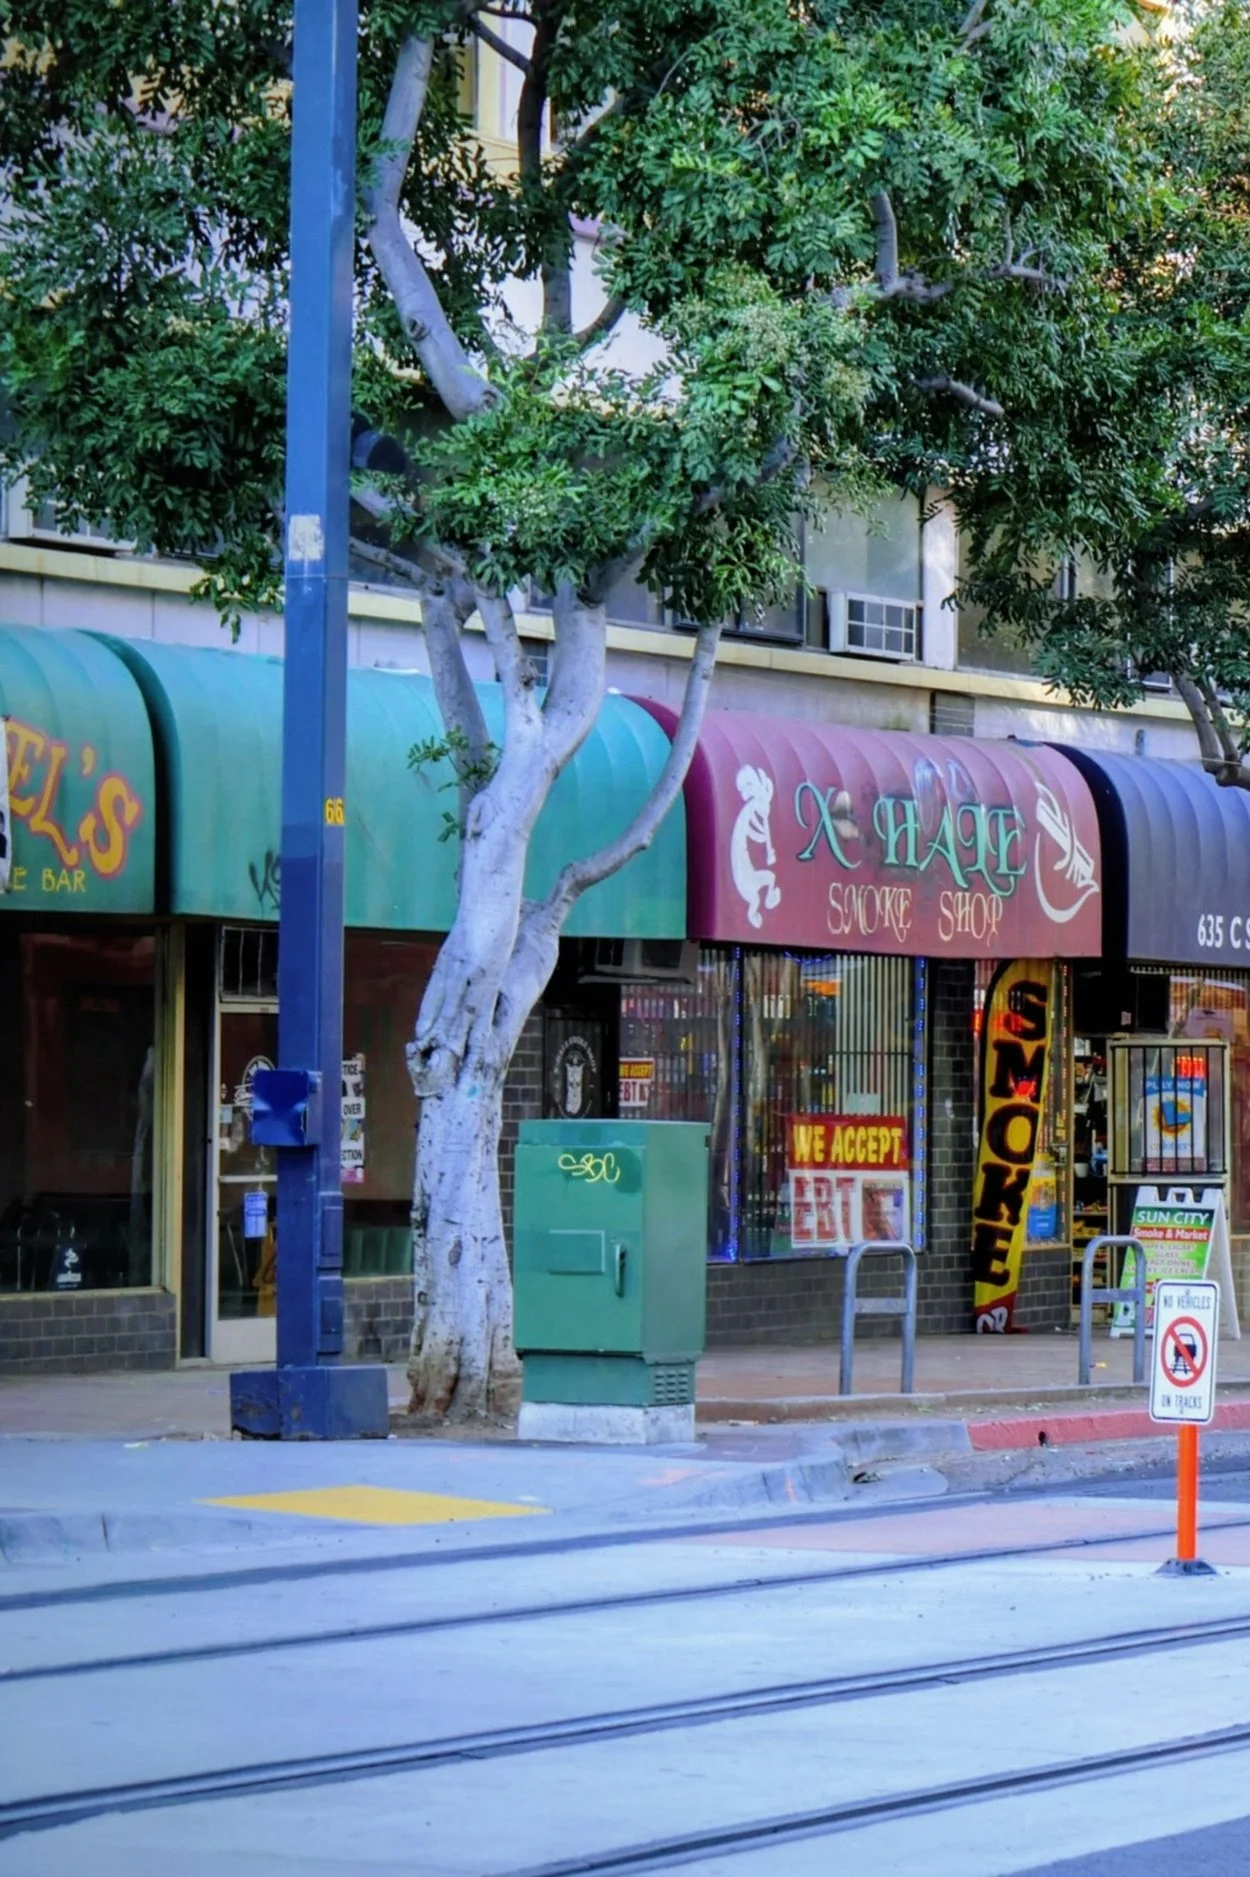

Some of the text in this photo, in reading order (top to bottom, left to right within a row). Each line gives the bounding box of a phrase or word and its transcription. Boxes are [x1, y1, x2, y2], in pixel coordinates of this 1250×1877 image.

[794, 781, 1026, 898] X HALE
[42, 867, 86, 893] BAR
[827, 881, 1004, 947] SMOKE SHOP
[1197, 914, 1224, 948] 635
[1229, 915, 1242, 949] C
[793, 1124, 903, 1165] WE ACCEPT
[971, 979, 1048, 1287] SMOKE
[1137, 1210, 1209, 1226] SUN CITY
[1134, 1227, 1164, 1239] Smoke
[1175, 1228, 1208, 1241] Market
[1163, 1293, 1211, 1310] NO VEHICLES
[1161, 1394, 1203, 1410] ON TRACKS
